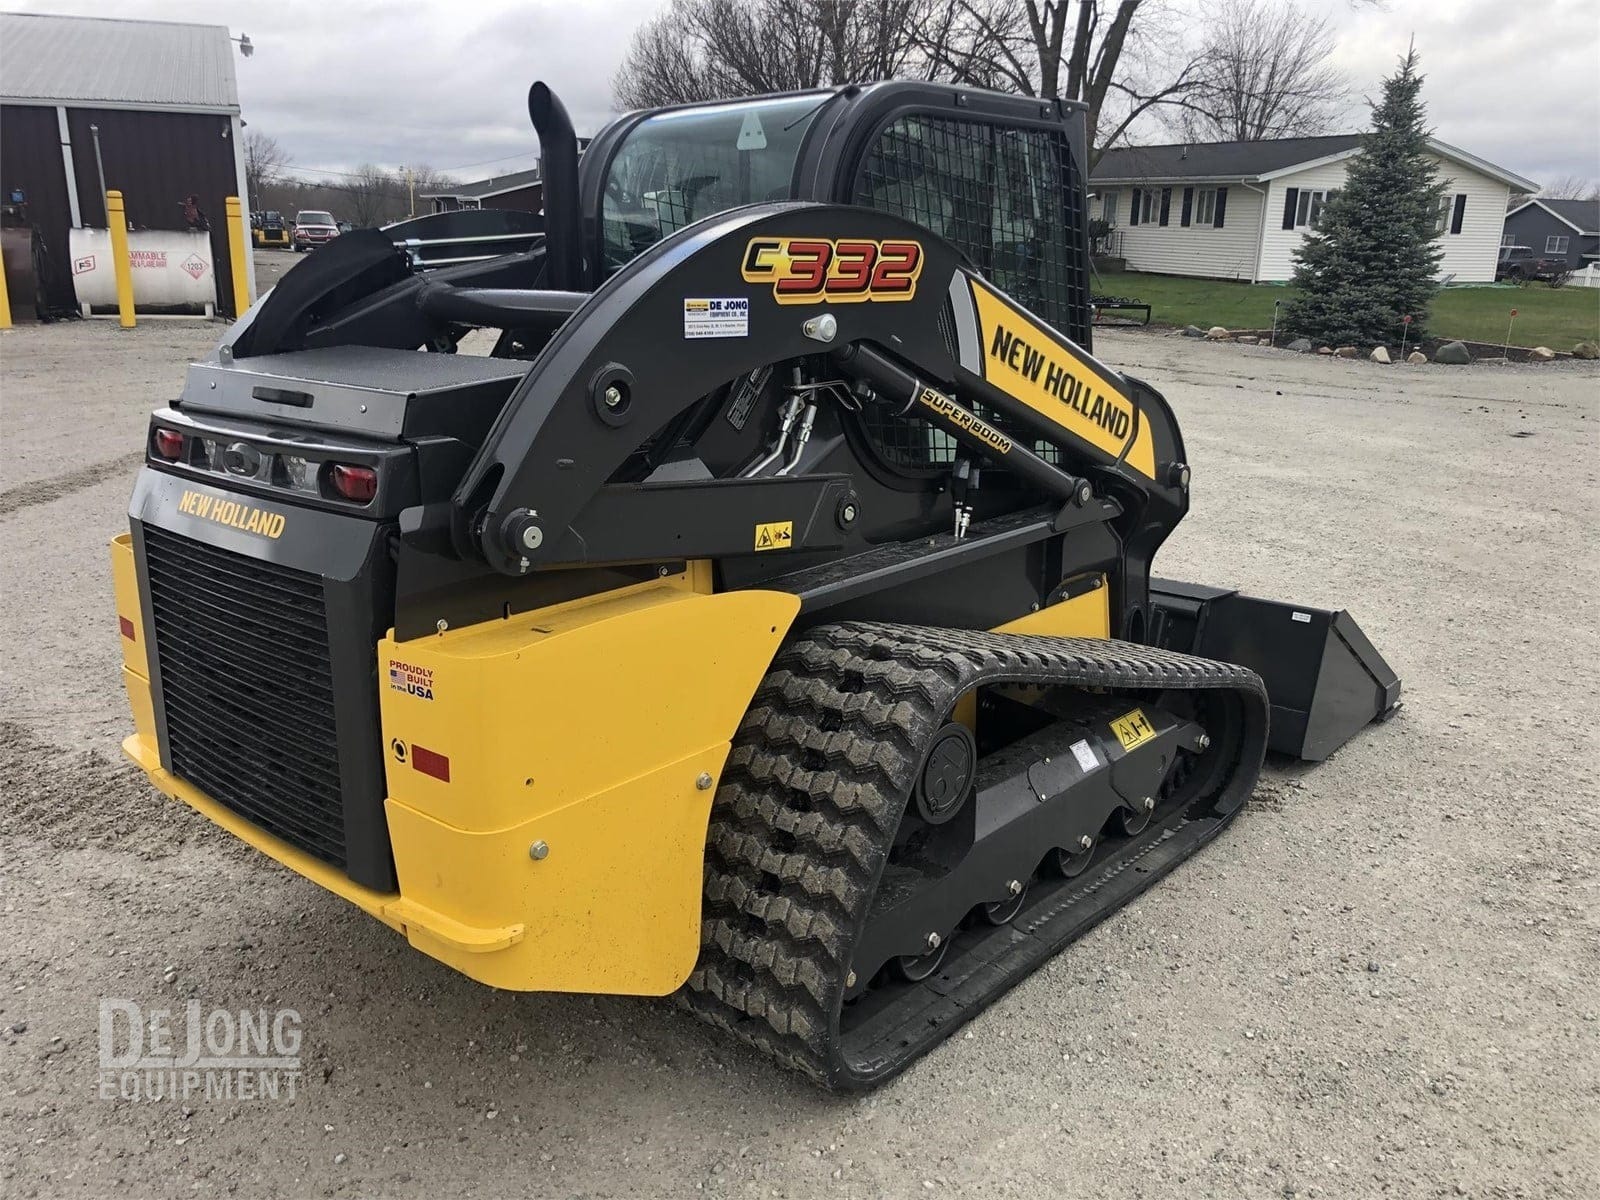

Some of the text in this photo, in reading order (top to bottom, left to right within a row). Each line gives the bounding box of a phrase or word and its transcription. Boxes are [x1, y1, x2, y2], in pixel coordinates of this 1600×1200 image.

[187, 262, 203, 271] 1203
[743, 239, 922, 300] C332
[710, 301, 748, 311] DE JONG
[990, 324, 1130, 441] NEW HOLLAND
[178, 489, 287, 539] NEW HOLLAND
[389, 659, 434, 678] PROUDLY
[407, 673, 434, 688] BUILT
[407, 683, 434, 701] USA
